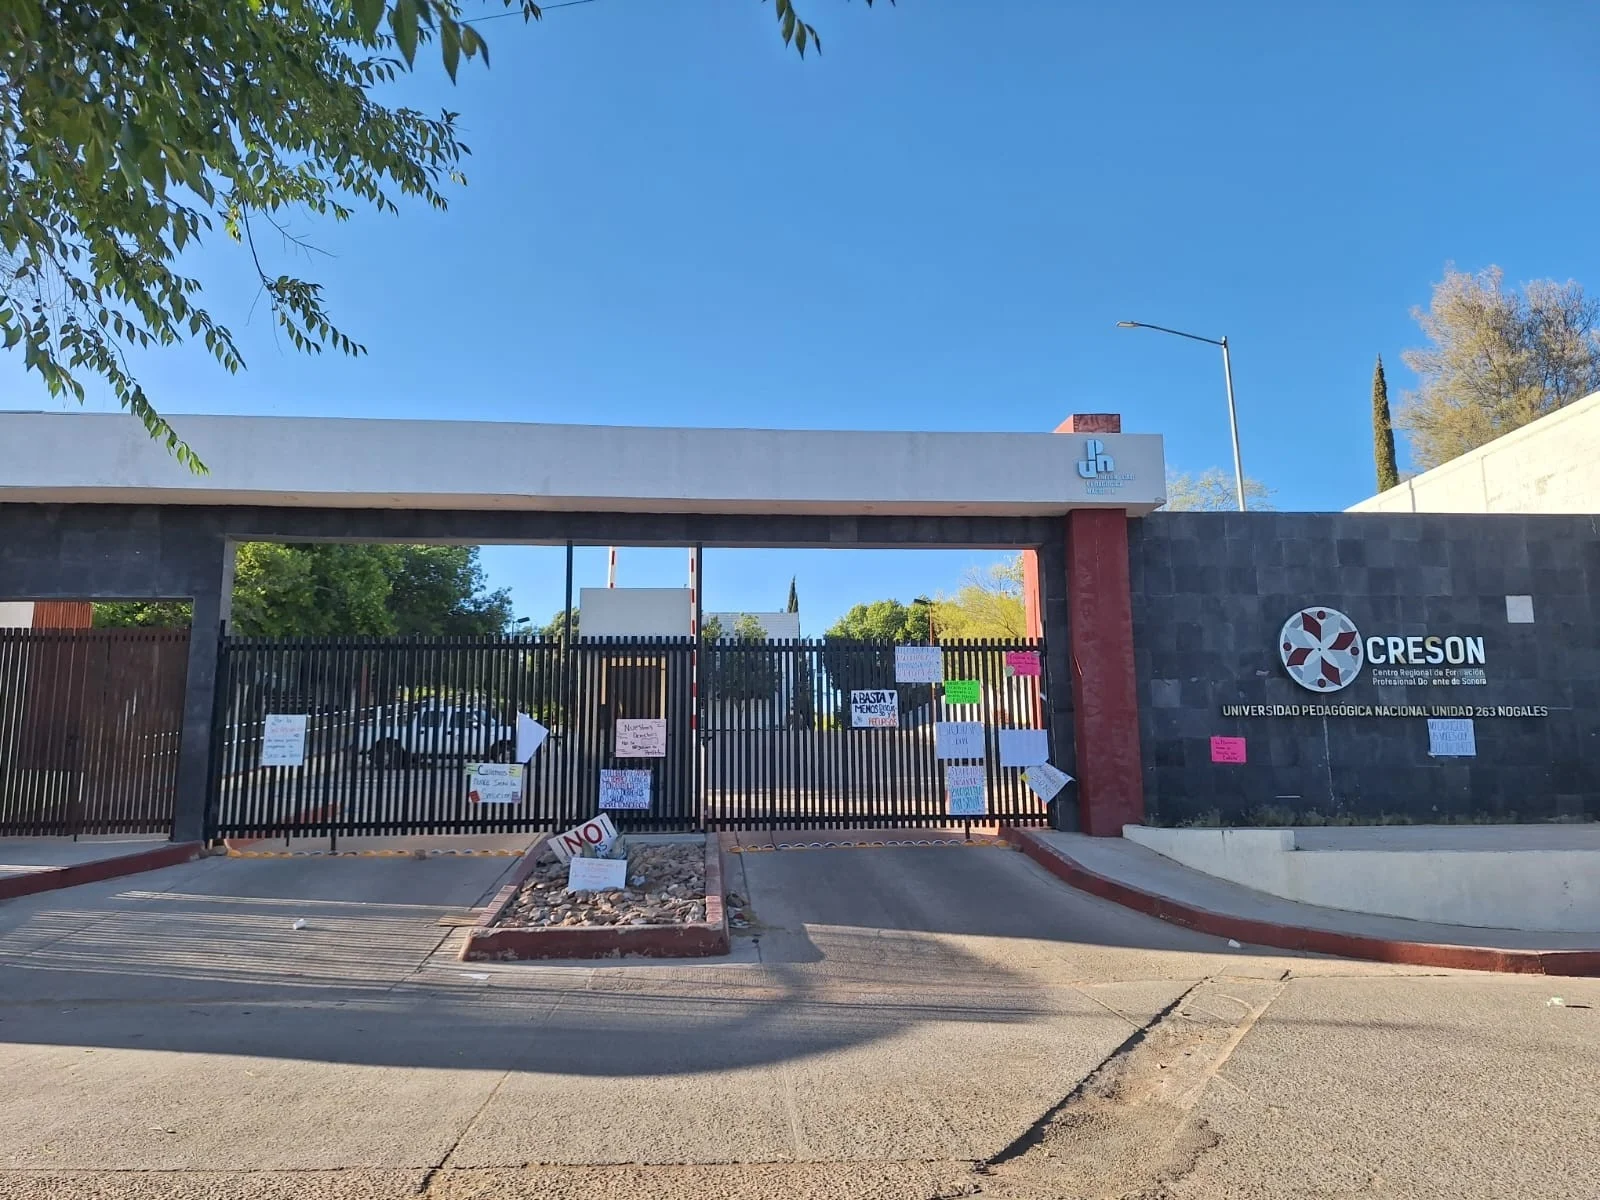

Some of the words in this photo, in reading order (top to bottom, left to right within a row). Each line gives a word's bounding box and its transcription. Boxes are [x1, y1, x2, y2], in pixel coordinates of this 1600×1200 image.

[1366, 636, 1486, 665] CRESON
[1372, 668, 1399, 677] Centro
[1400, 668, 1432, 678] Regional
[1434, 668, 1443, 677] de
[1445, 667, 1485, 677] Foración
[1372, 677, 1416, 686] Profesional
[1417, 677, 1450, 686] Doente
[1451, 677, 1460, 686] de
[1461, 677, 1487, 686] Sonora
[854, 704, 879, 714] MENOS
[1223, 704, 1300, 717] UNIVERSIDAD
[1302, 701, 1373, 717] PEDAGÓGICA
[1375, 705, 1430, 717] NACIONAL
[1431, 705, 1474, 717] UNIDAD
[1475, 705, 1496, 717] 263
[1498, 705, 1549, 717] NOGALES
